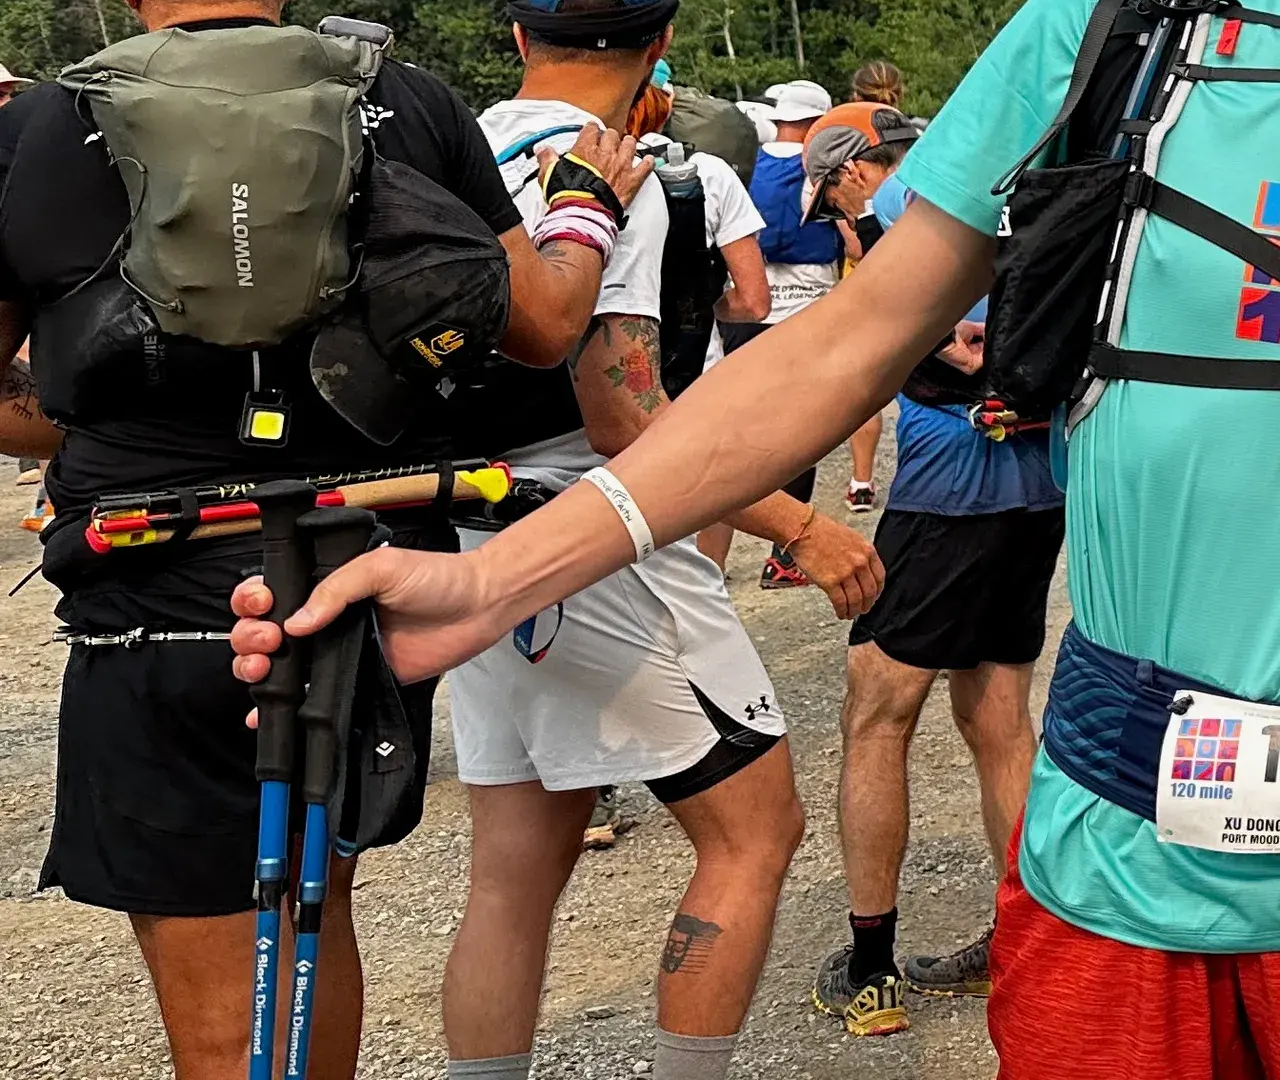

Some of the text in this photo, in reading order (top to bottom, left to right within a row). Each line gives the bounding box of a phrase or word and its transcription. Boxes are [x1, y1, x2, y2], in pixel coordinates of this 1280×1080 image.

[232, 182, 254, 288] SALOMON
[1178, 719, 1242, 738] FAT
[1175, 738, 1240, 760] DOG
[1171, 759, 1237, 782] 120
[1170, 782, 1233, 800] 120 mile
[1224, 816, 1242, 831] XU
[1221, 833, 1247, 844] PORT
[253, 953, 268, 1055] Black Diamond
[287, 976, 308, 1076] Black Diamond
